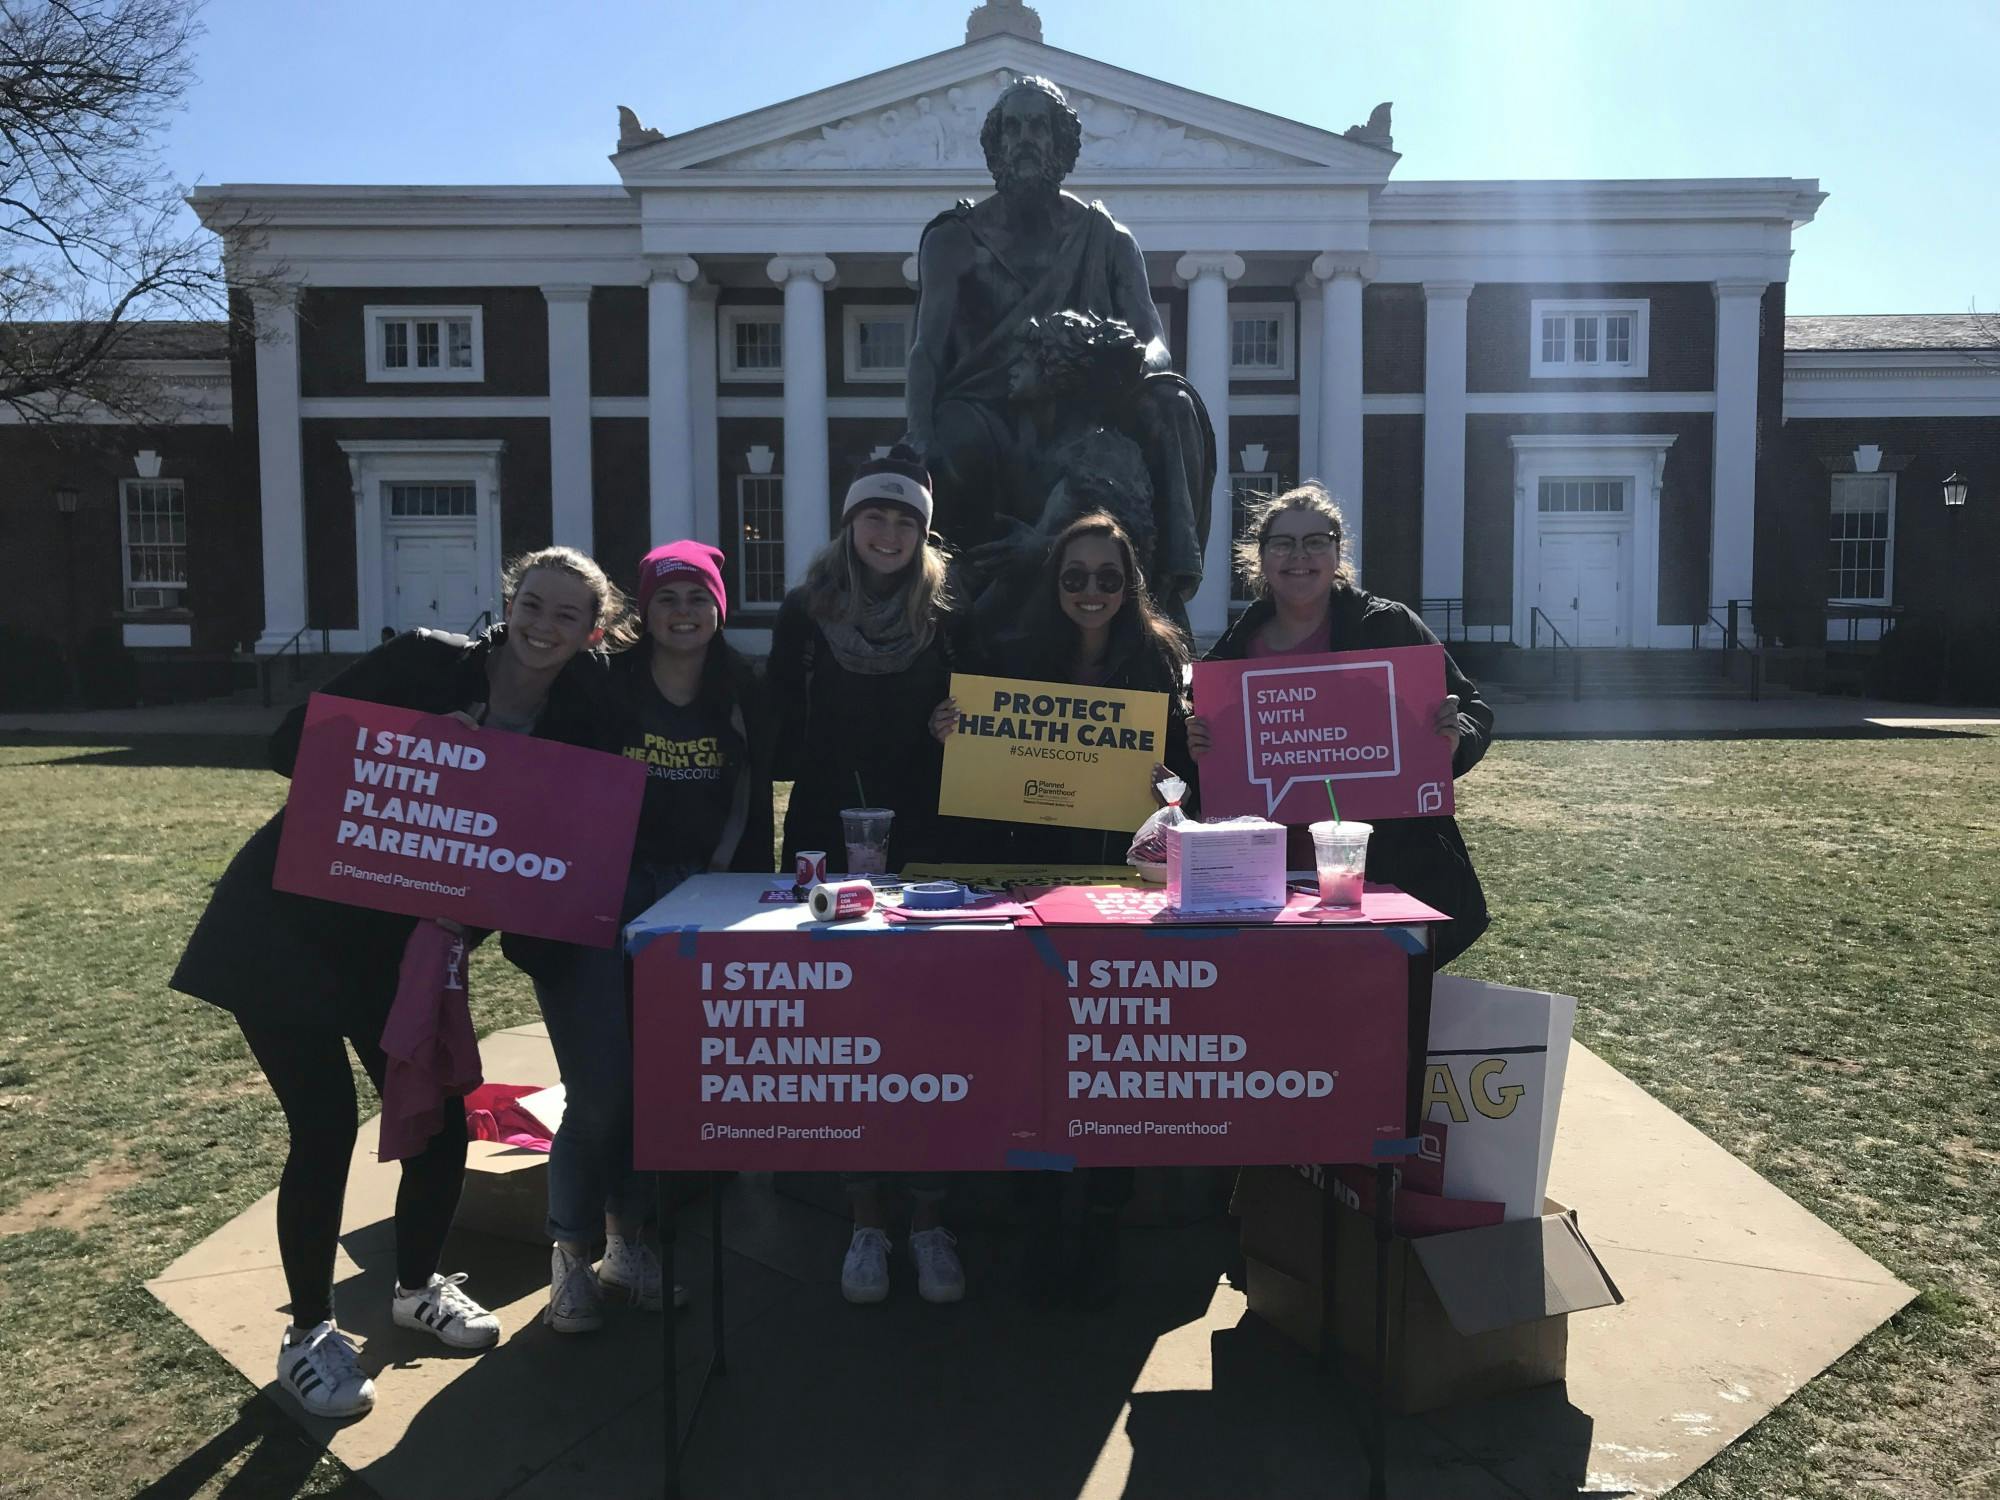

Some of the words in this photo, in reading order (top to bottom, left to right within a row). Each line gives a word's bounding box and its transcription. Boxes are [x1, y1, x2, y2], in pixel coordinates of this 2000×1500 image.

[993, 691, 1126, 723] PROTECT
[1257, 687, 1317, 704] STAND
[1258, 710, 1305, 725] WITH
[643, 732, 718, 754] PROTECT
[958, 714, 1069, 744] HEALTH
[1078, 724, 1155, 752] CARE
[1260, 727, 1348, 746] PLANNED
[355, 727, 368, 751] I
[373, 731, 487, 772] STAND
[622, 746, 690, 768] HEALTH
[694, 752, 728, 768] CAR
[1010, 746, 1099, 763] #SAVESCOTUS
[1262, 745, 1389, 766] PARENTHOOD
[353, 758, 440, 796] WITH
[1039, 780, 1065, 789] Planned
[1039, 787, 1076, 797] Parenthood
[343, 789, 498, 838] PLANNED
[336, 820, 568, 882] PARENTHOOD
[344, 865, 393, 884] Planned
[393, 873, 467, 897] Parenthood
[701, 962, 712, 991] I
[723, 961, 853, 991] STAND
[1068, 960, 1078, 988] I
[1088, 959, 1218, 989] STAND
[702, 999, 805, 1028] WITH
[1069, 997, 1170, 1025] WITH
[701, 1036, 882, 1065] PLANNED
[1068, 1034, 1247, 1062] PLANNED
[701, 1073, 969, 1103] PARENTHOOD
[1068, 1070, 1334, 1099] PARENTHOOD
[717, 1124, 775, 1139] Planned
[777, 1124, 861, 1139] Parenthood
[1084, 1120, 1141, 1136] Planned
[1144, 1120, 1228, 1136] Parenthood
